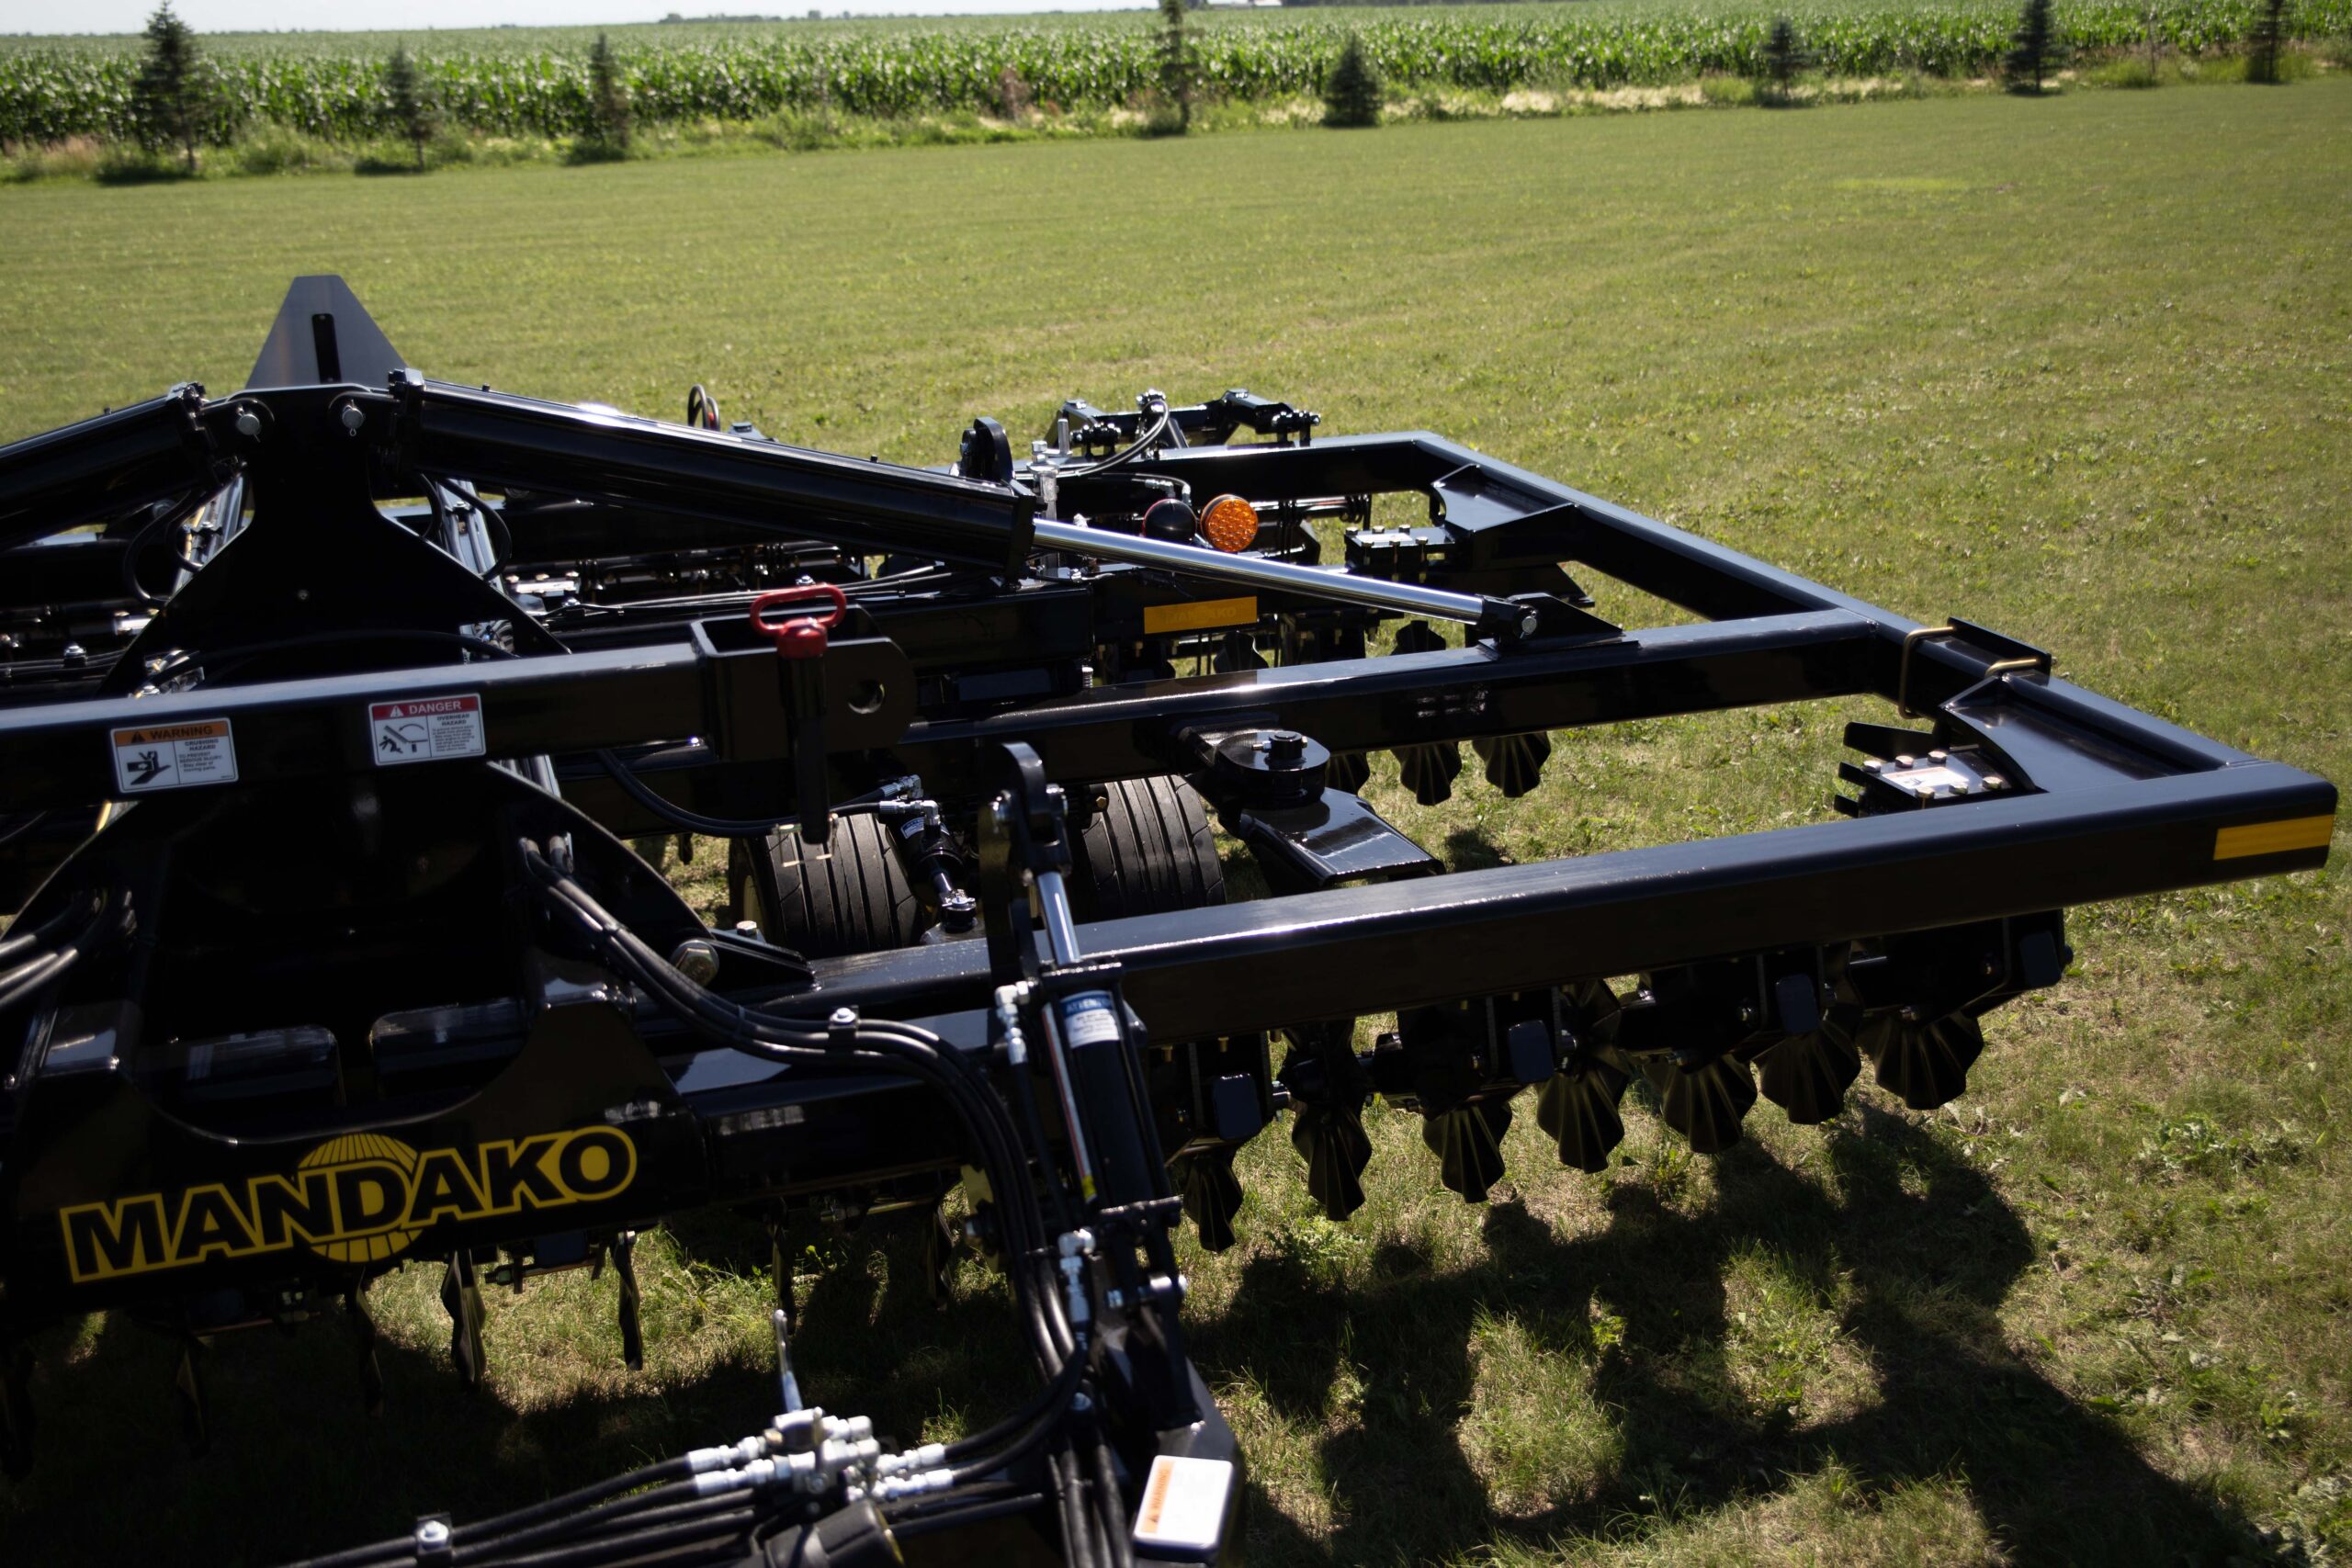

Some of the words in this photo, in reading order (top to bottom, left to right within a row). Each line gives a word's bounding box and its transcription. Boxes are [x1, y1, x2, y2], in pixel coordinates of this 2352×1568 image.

[409, 701, 462, 715] DANGER
[150, 726, 213, 740] WARNING
[59, 1125, 638, 1283] MANDAKO
[1149, 1470, 1170, 1509] WARNING
